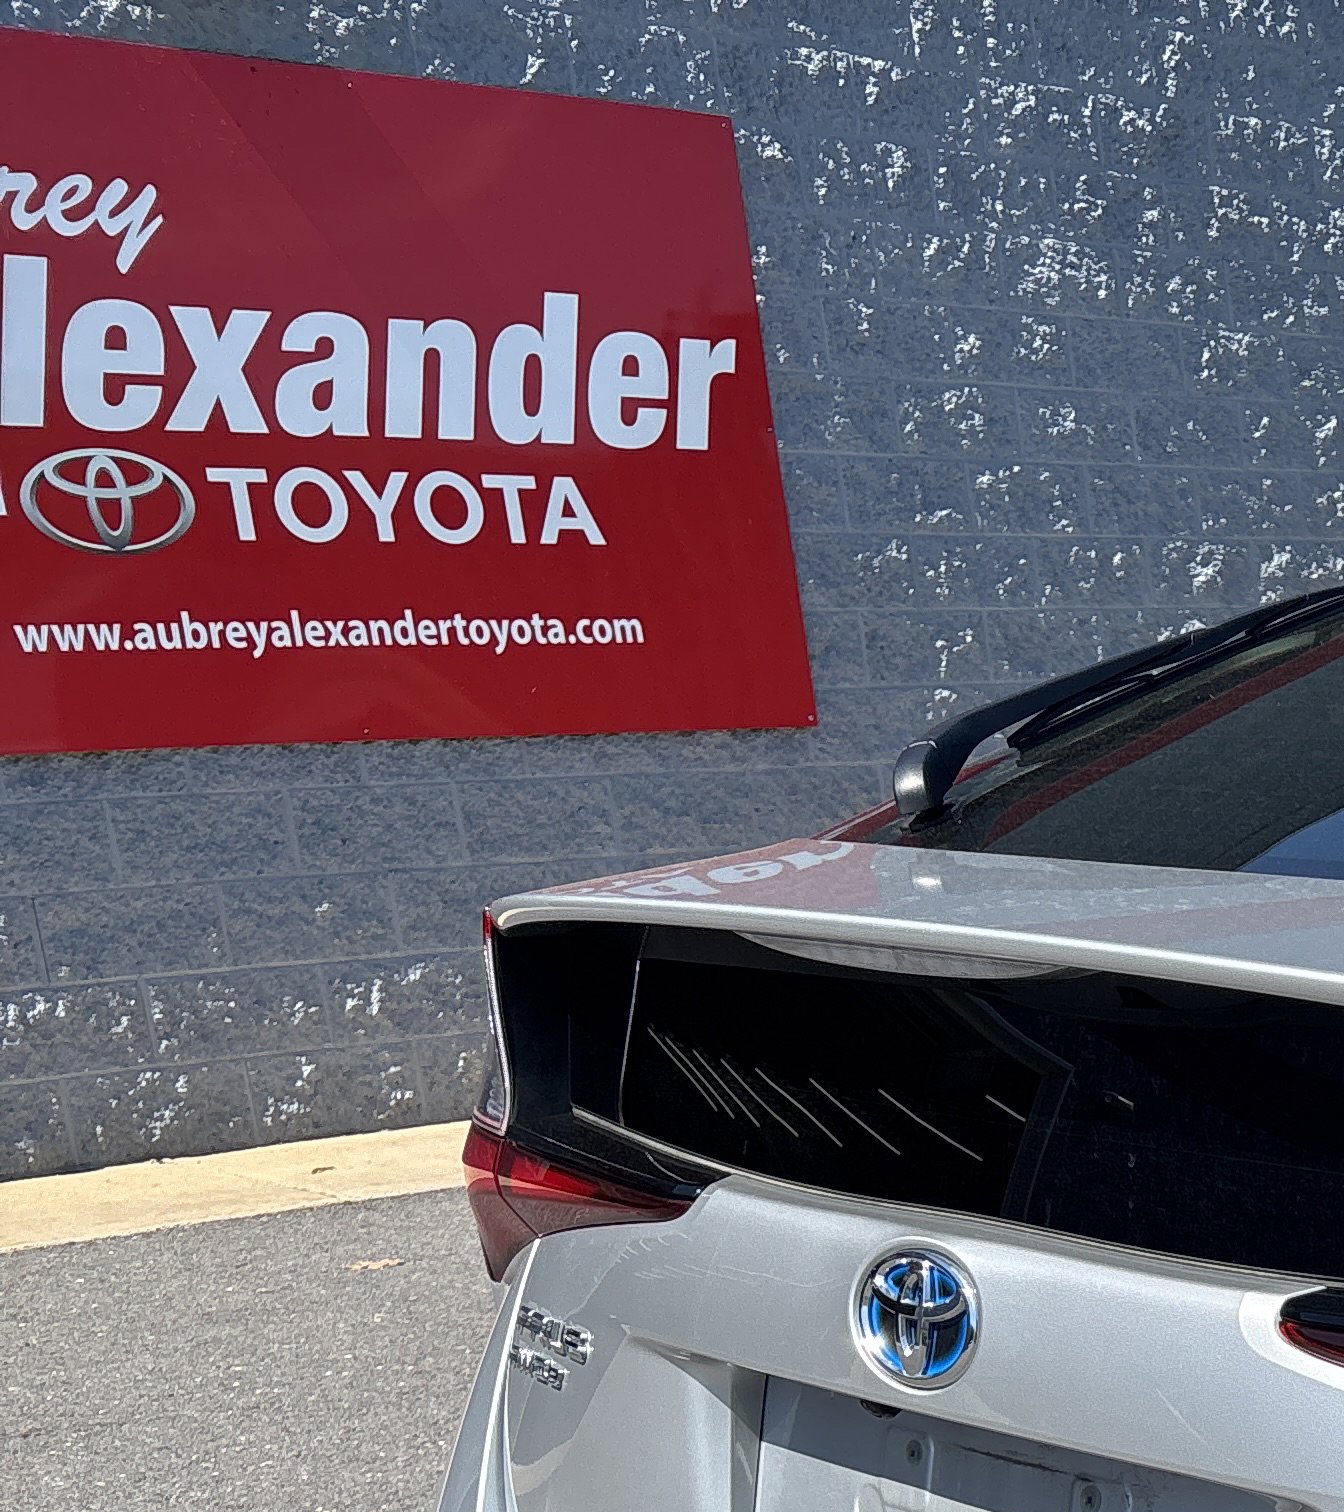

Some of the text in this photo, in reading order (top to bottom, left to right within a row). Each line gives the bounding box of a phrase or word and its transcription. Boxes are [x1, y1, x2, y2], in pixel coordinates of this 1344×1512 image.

[2, 253, 737, 451] lexander
[205, 466, 607, 546] TOYOTA
[12, 608, 645, 659] www.aubreyalexandertoyota.com
